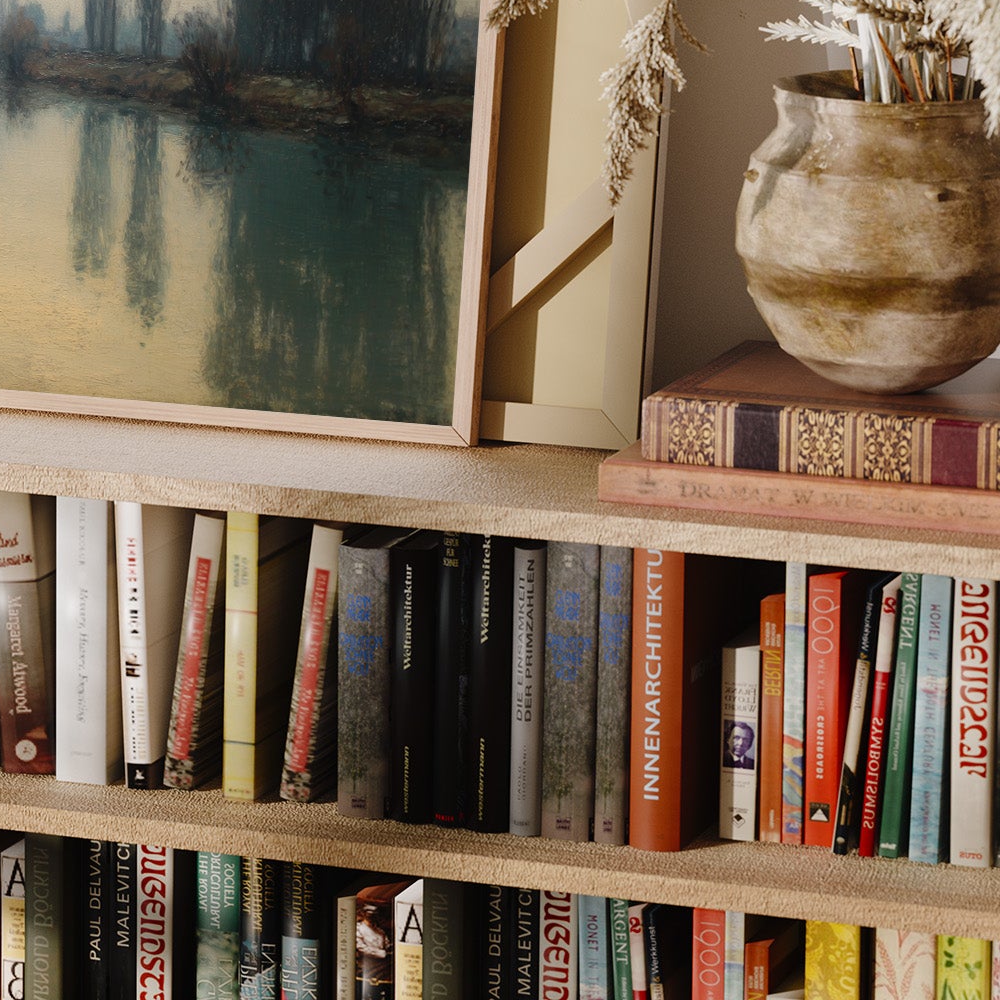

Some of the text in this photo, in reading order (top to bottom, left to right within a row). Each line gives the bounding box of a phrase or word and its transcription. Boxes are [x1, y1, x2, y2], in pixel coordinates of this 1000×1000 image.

[5, 595, 32, 714] Margaret Atwood
[402, 563, 413, 671] Weltarchitektur
[515, 574, 527, 721] DIE EINSAMKEIT
[524, 558, 536, 723] DER PRIMZAHLEN
[643, 550, 663, 802] INNENARCHITEKTU
[402, 745, 410, 814] westermann
[477, 737, 486, 822] westermann
[89, 839, 102, 961] PAUL DELVAU
[488, 886, 501, 957] DELVAU
[587, 914, 599, 952] MONET
[613, 898, 629, 965] ARGENT
[648, 925, 660, 975] Werkkunst
[693, 921, 721, 987] 1900
